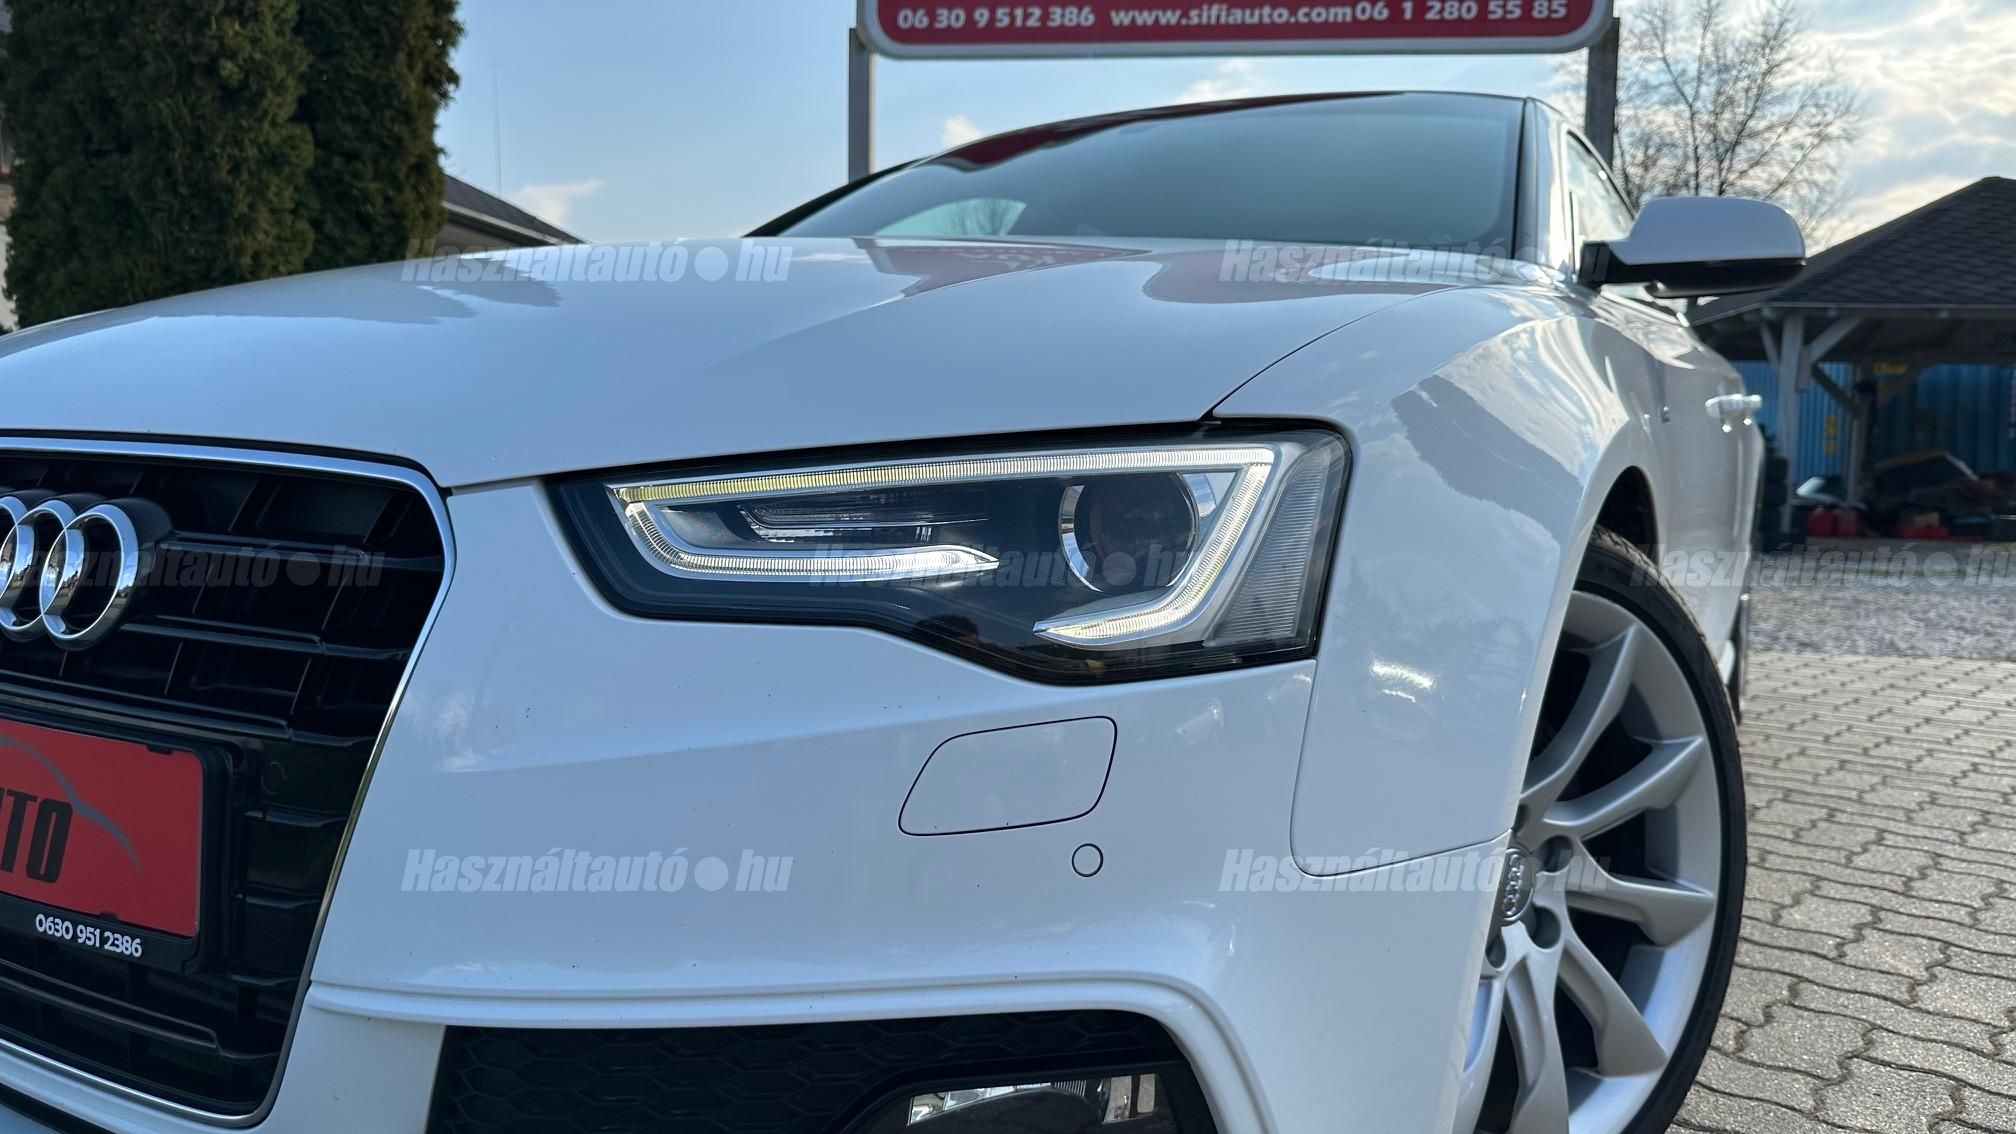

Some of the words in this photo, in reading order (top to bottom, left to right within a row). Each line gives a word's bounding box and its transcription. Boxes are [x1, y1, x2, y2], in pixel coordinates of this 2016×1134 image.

[897, 8, 930, 29] 06
[933, 8, 966, 29] 30
[1046, 6, 1096, 28] 386
[1109, 3, 1353, 26] www.sifiauto.com
[1354, 1, 1390, 20] 06
[1402, 1, 1414, 20] 1
[1424, 0, 1478, 20] 280
[1487, 0, 1522, 20] 55
[1531, 0, 1567, 19] 85
[0, 787, 73, 884] TO
[35, 913, 74, 940] 0630
[77, 924, 101, 948] 951
[103, 931, 143, 958] 2386
